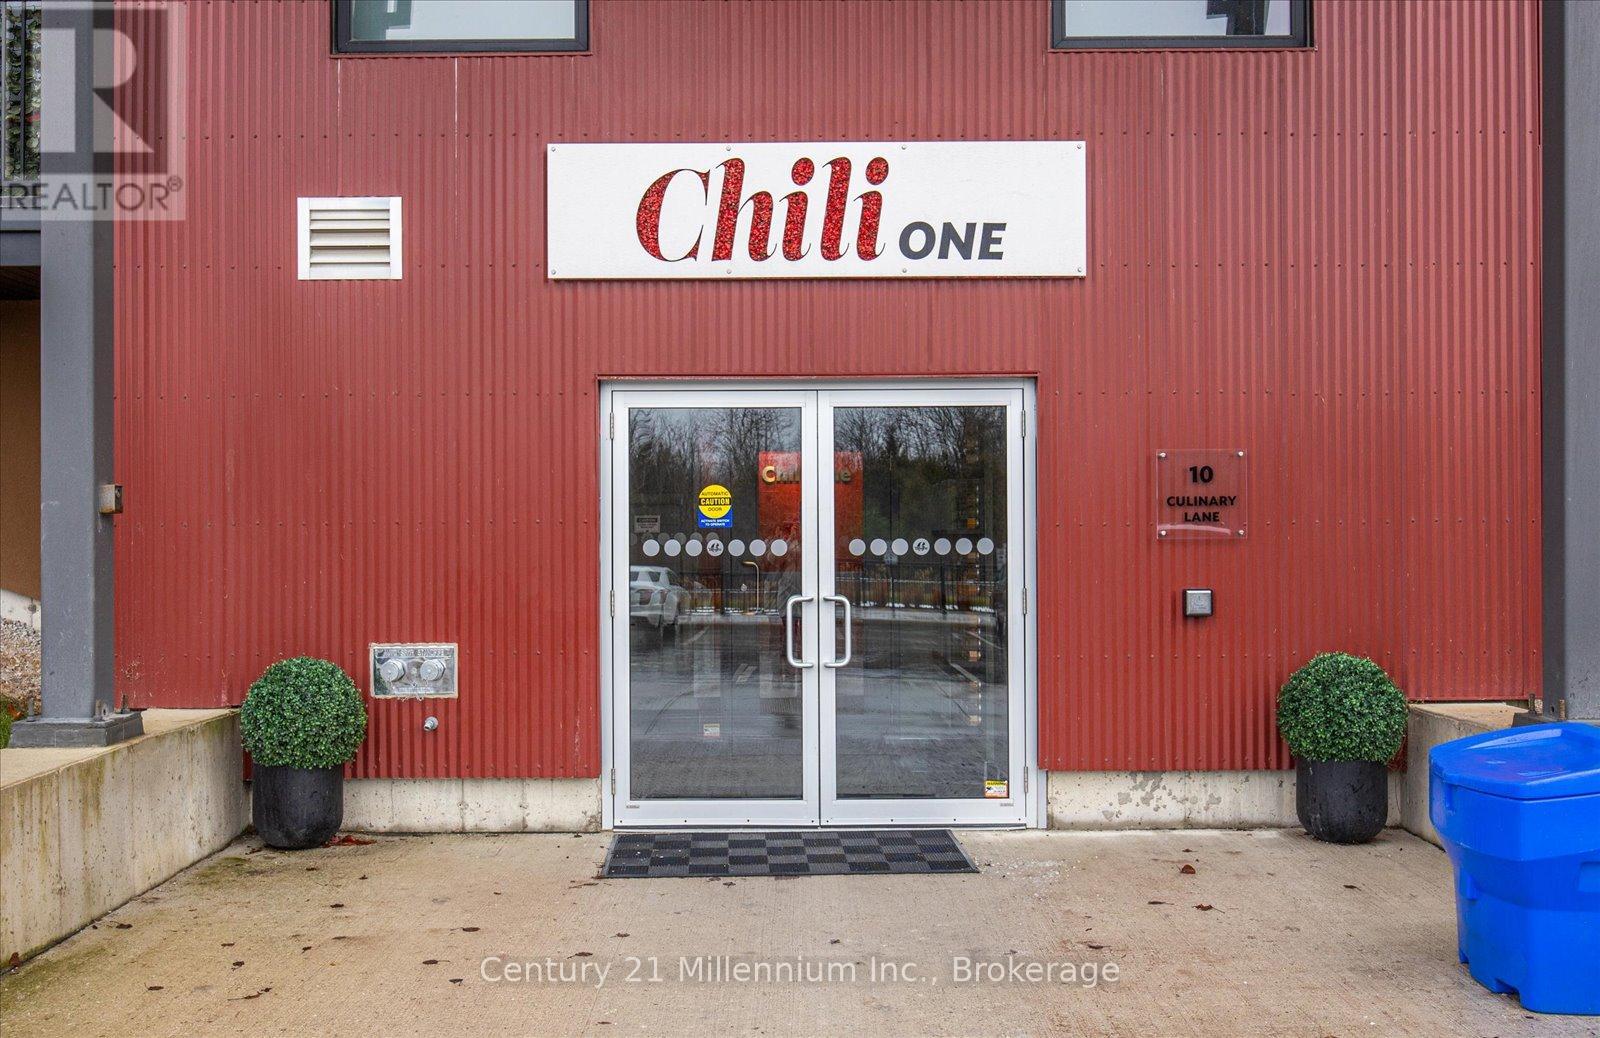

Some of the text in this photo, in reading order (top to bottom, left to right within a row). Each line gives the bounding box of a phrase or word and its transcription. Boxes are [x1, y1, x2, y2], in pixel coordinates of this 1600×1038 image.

[636, 157, 1007, 262] Chili ONE
[1189, 465, 1214, 483] 10
[700, 498, 730, 506] CAUTION
[1166, 496, 1237, 507] CULINARY
[1184, 512, 1220, 522] LANE
